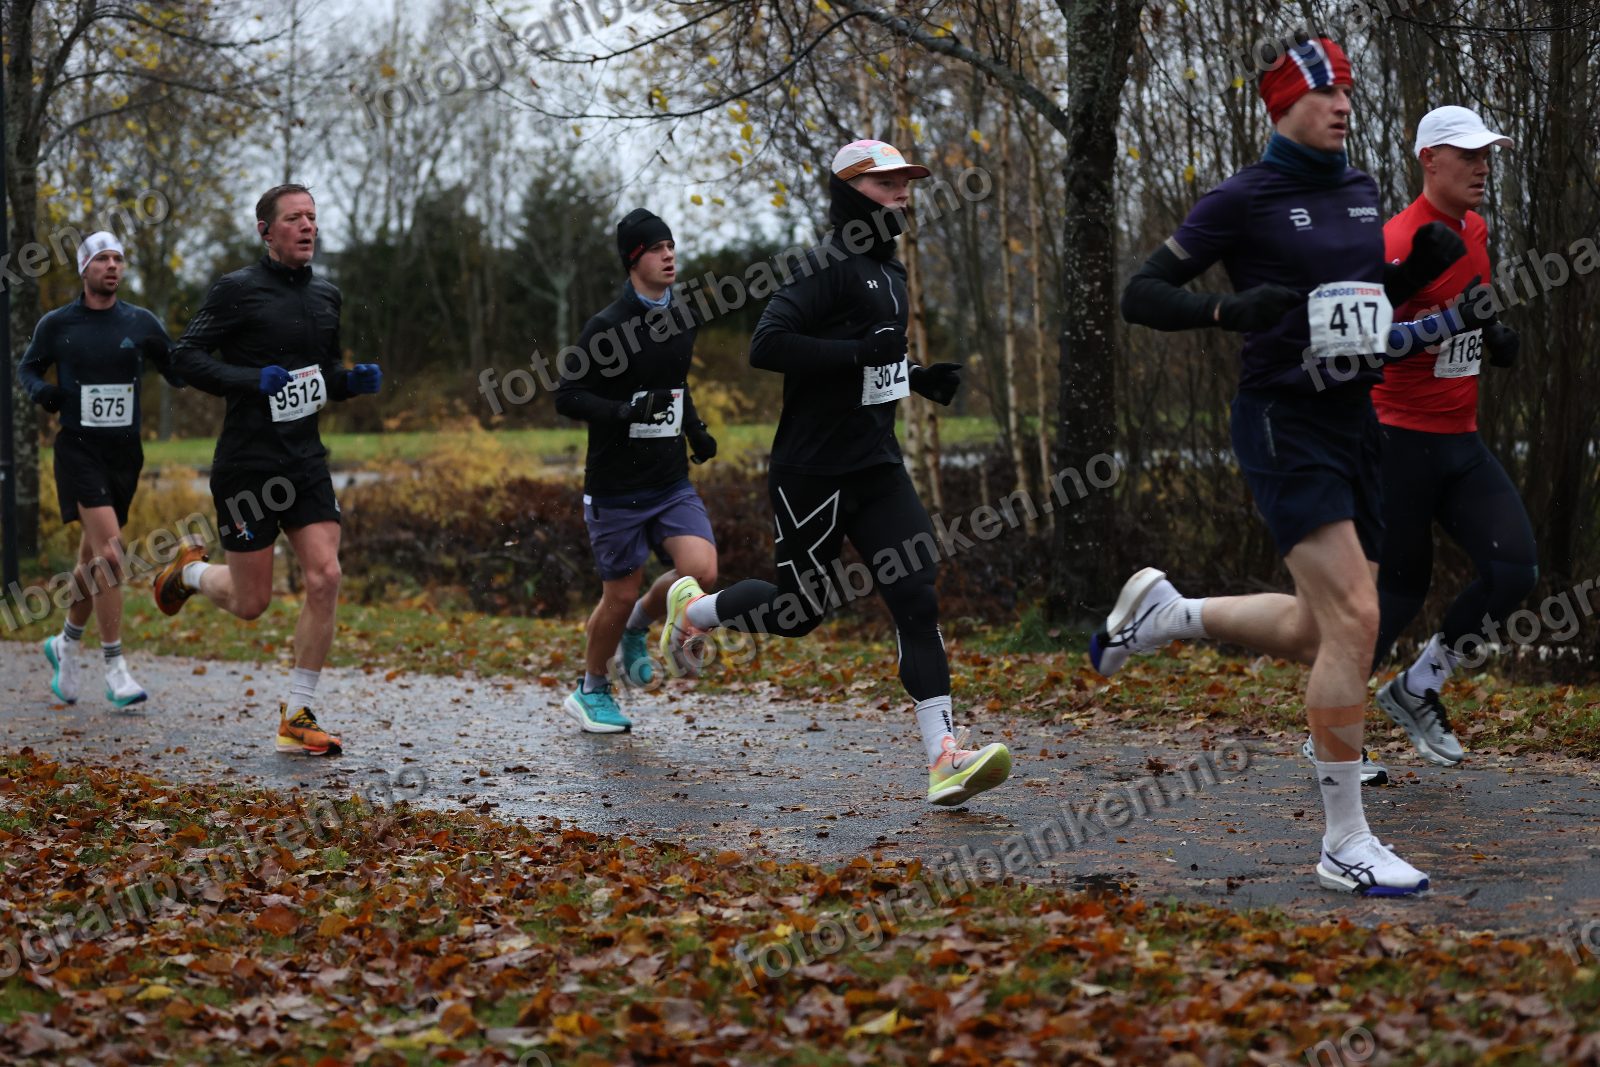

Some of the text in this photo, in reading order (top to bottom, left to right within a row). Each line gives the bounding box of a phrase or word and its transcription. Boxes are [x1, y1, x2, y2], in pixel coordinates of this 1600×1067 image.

[1329, 301, 1378, 337] 417
[1448, 334, 1482, 363] 1185
[874, 362, 906, 390] 362
[92, 397, 125, 418] 675
[275, 378, 322, 411] 9512
